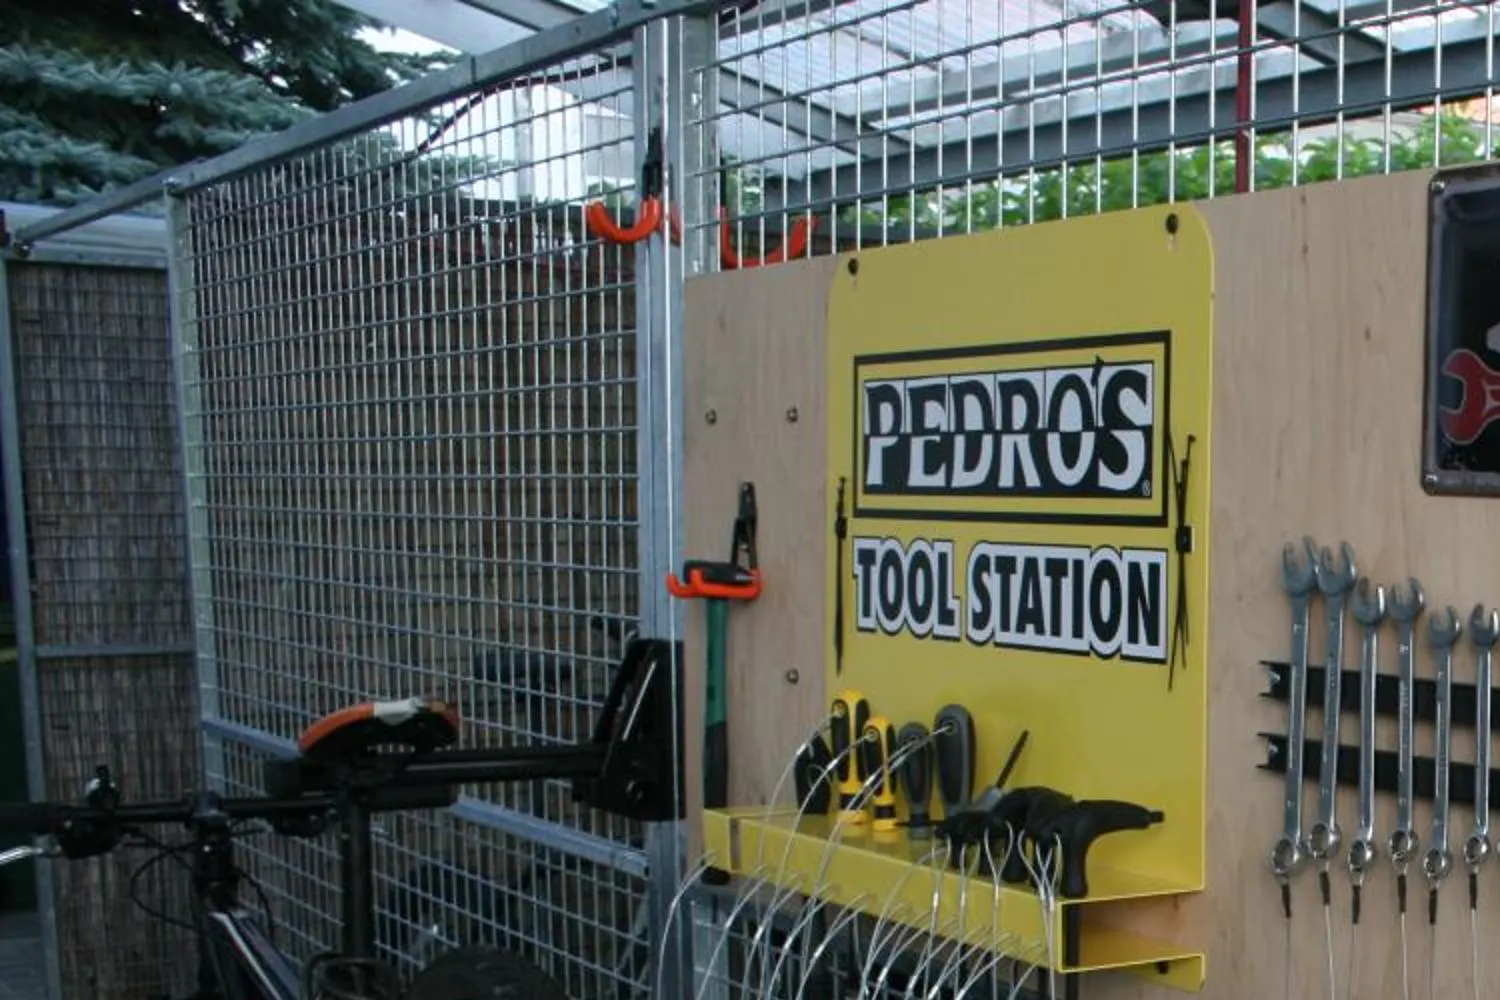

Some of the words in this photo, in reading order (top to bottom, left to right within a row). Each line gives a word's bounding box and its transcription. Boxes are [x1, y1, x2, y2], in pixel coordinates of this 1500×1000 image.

[864, 356, 1151, 494] PEDRO'S
[857, 548, 955, 634] TOOL
[971, 551, 1163, 648] STATION
